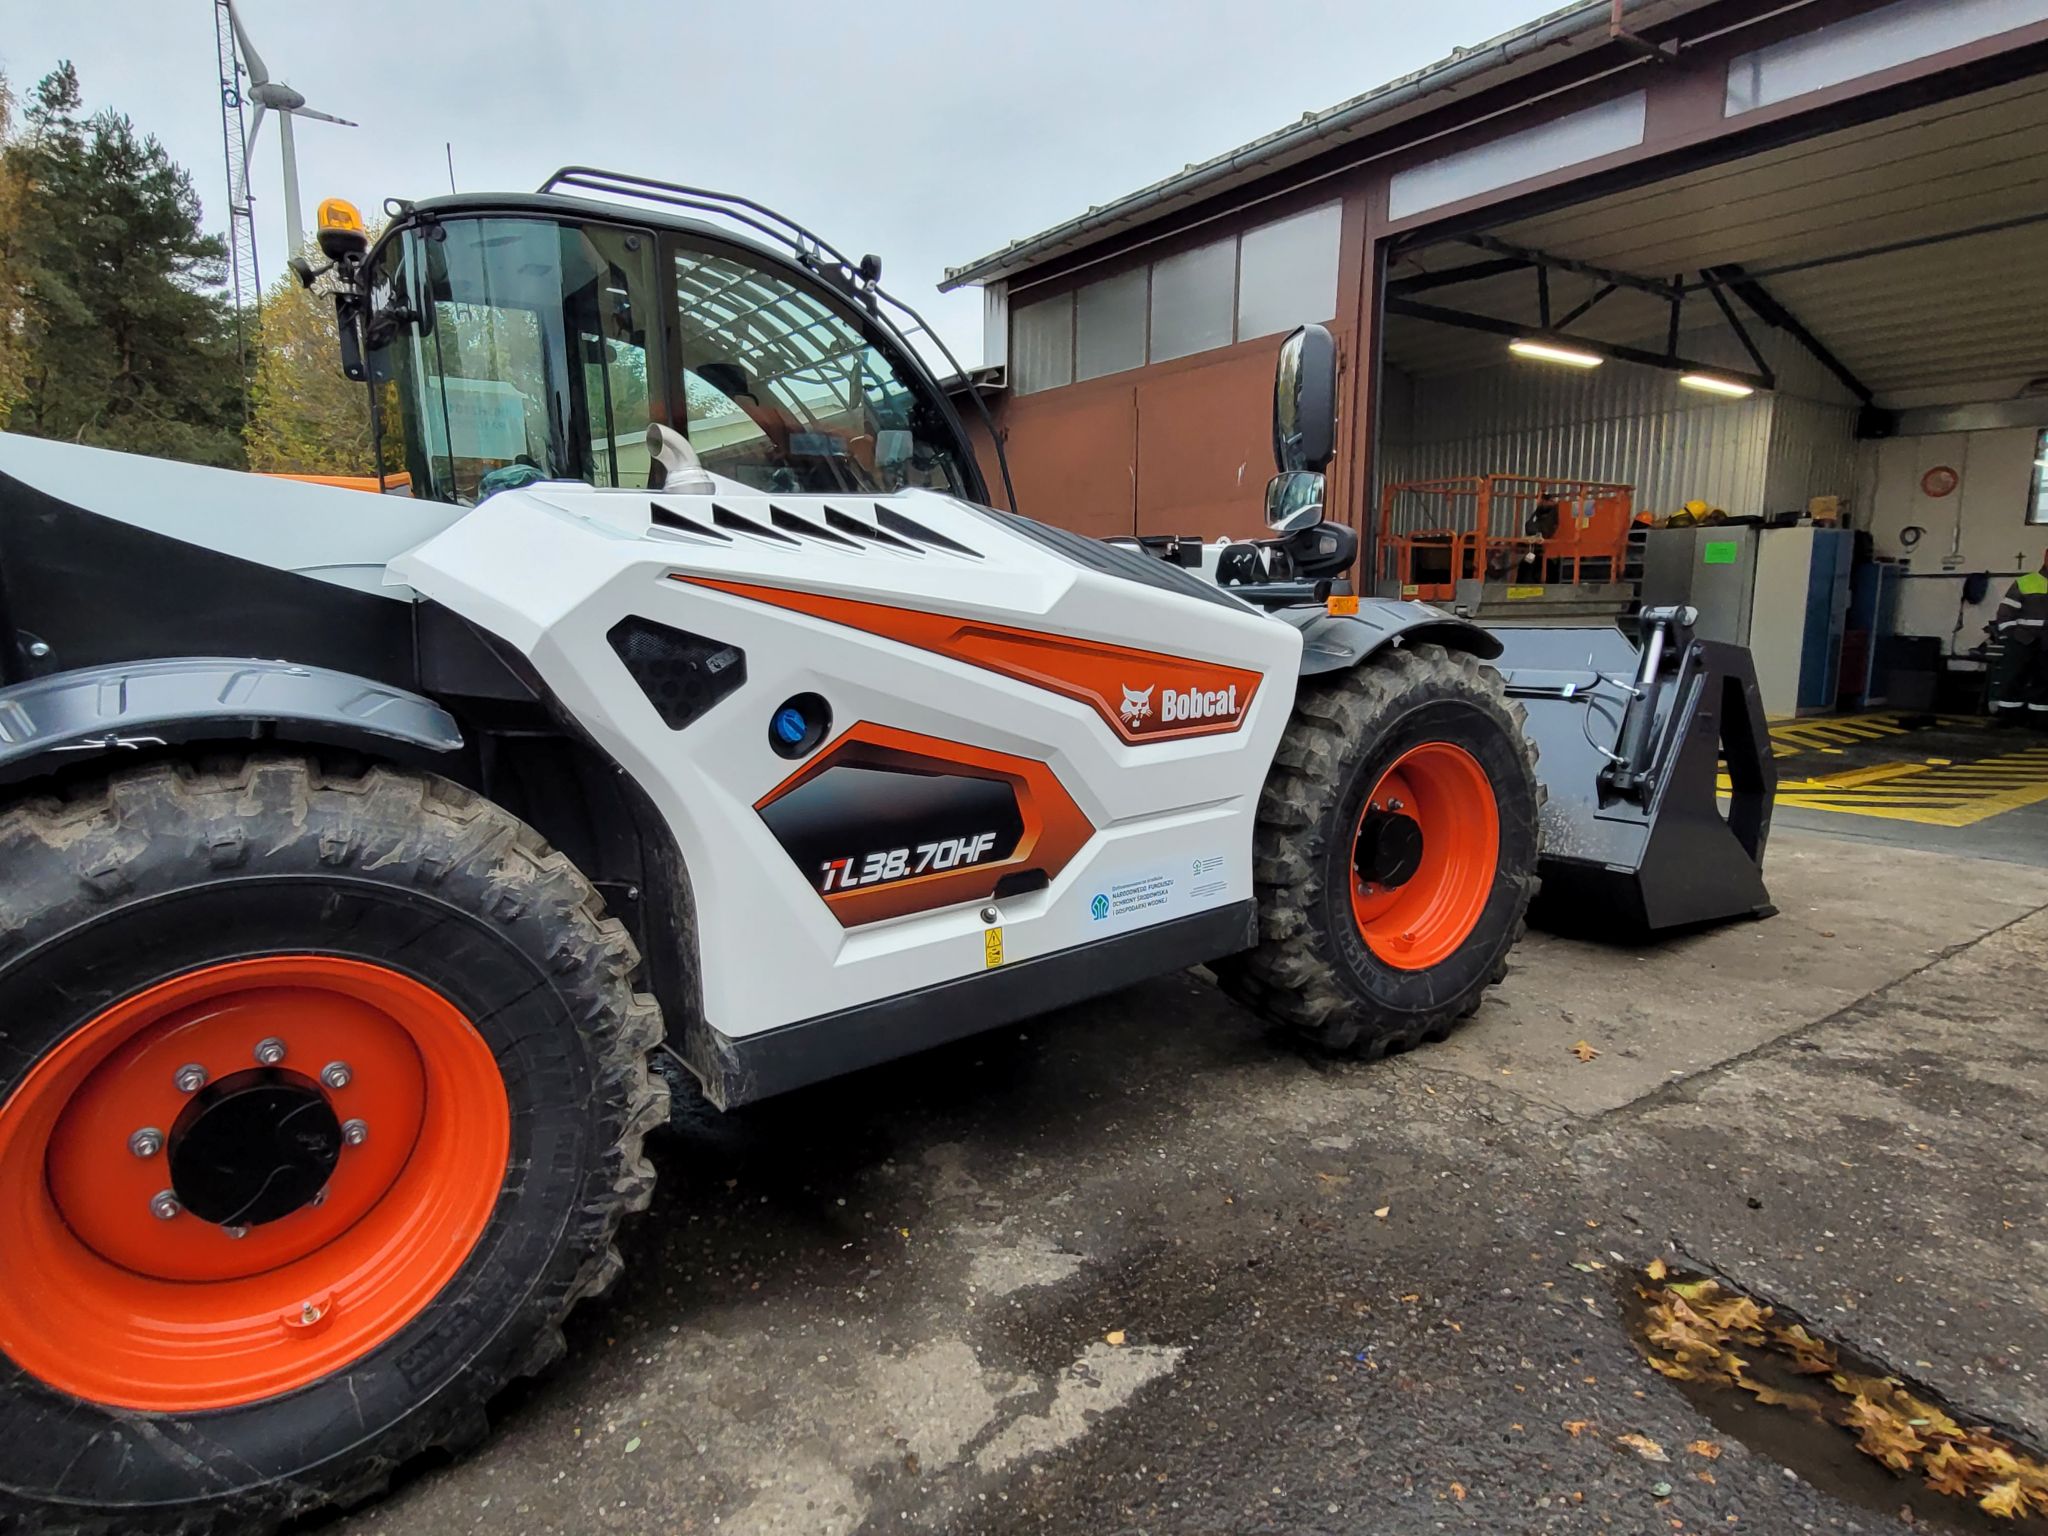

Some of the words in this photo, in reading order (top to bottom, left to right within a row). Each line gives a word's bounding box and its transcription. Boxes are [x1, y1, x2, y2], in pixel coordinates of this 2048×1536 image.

[1162, 684, 1237, 722] Bobcat
[821, 831, 997, 891] TL38.70HF
[1112, 896, 1136, 908] OCHRONY
[1147, 897, 1168, 907] WODNEJ
